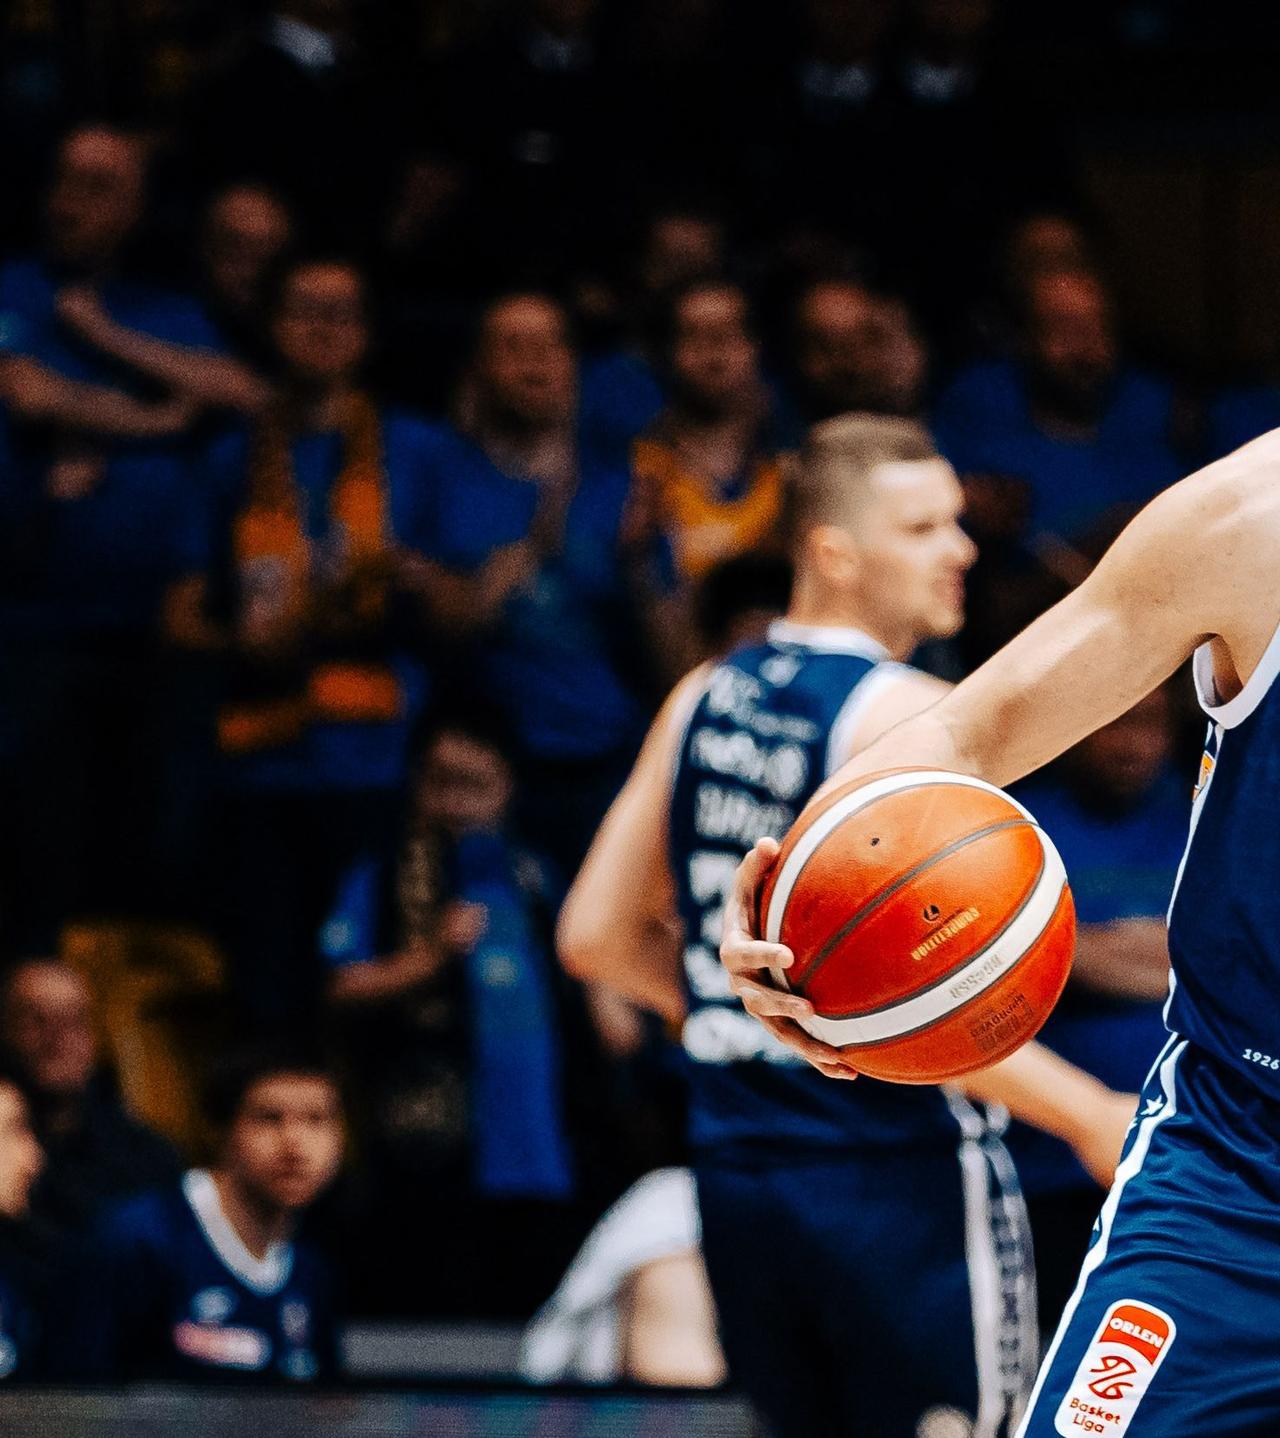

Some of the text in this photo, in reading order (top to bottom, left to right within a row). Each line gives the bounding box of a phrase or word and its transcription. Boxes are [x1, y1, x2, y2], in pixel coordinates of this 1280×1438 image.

[1242, 1048, 1280, 1071] 1926
[1109, 1317, 1164, 1349] ORLEN
[1070, 1397, 1121, 1424] Basket
[1073, 1413, 1105, 1433] Liga
